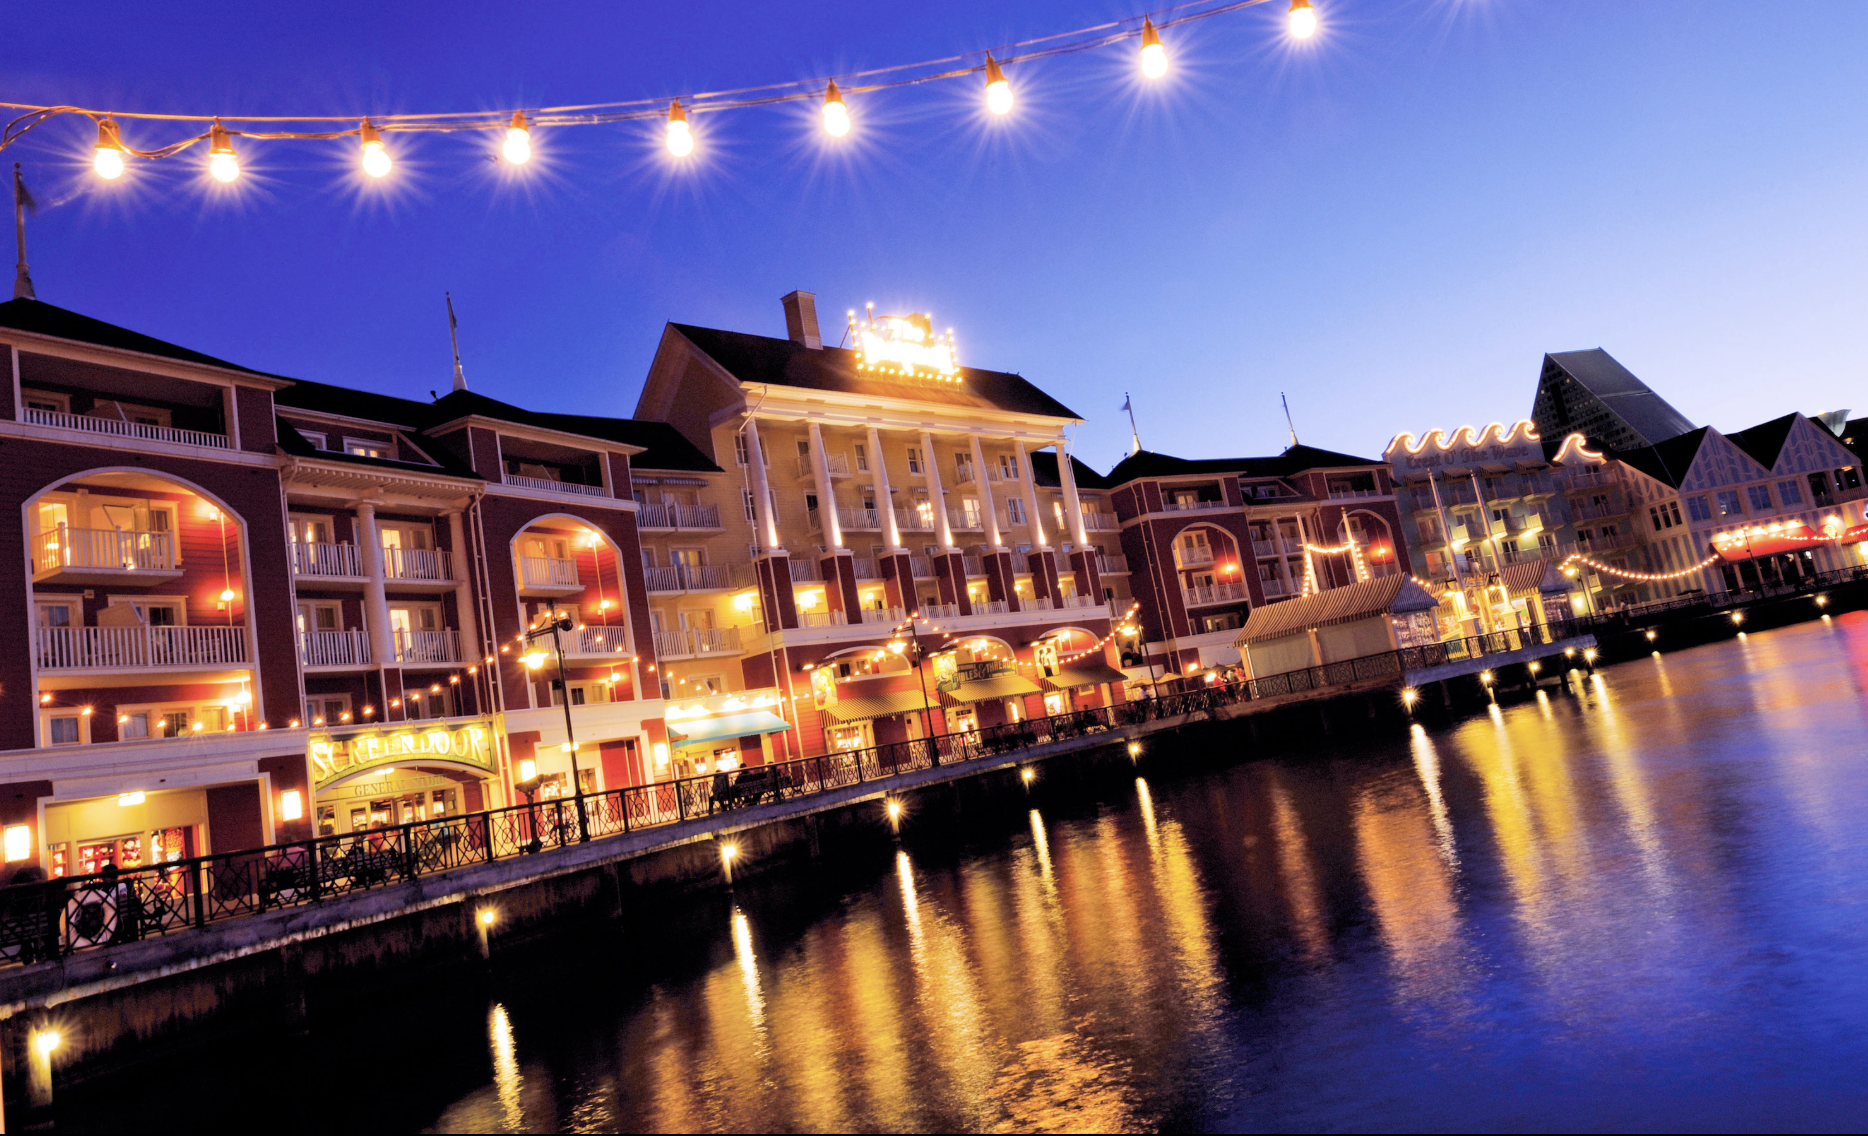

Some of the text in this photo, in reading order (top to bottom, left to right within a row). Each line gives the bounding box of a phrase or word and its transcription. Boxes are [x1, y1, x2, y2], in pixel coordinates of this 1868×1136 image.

[1406, 454, 1442, 470] Crest
[1460, 446, 1488, 463] The
[1490, 444, 1529, 460] Wave
